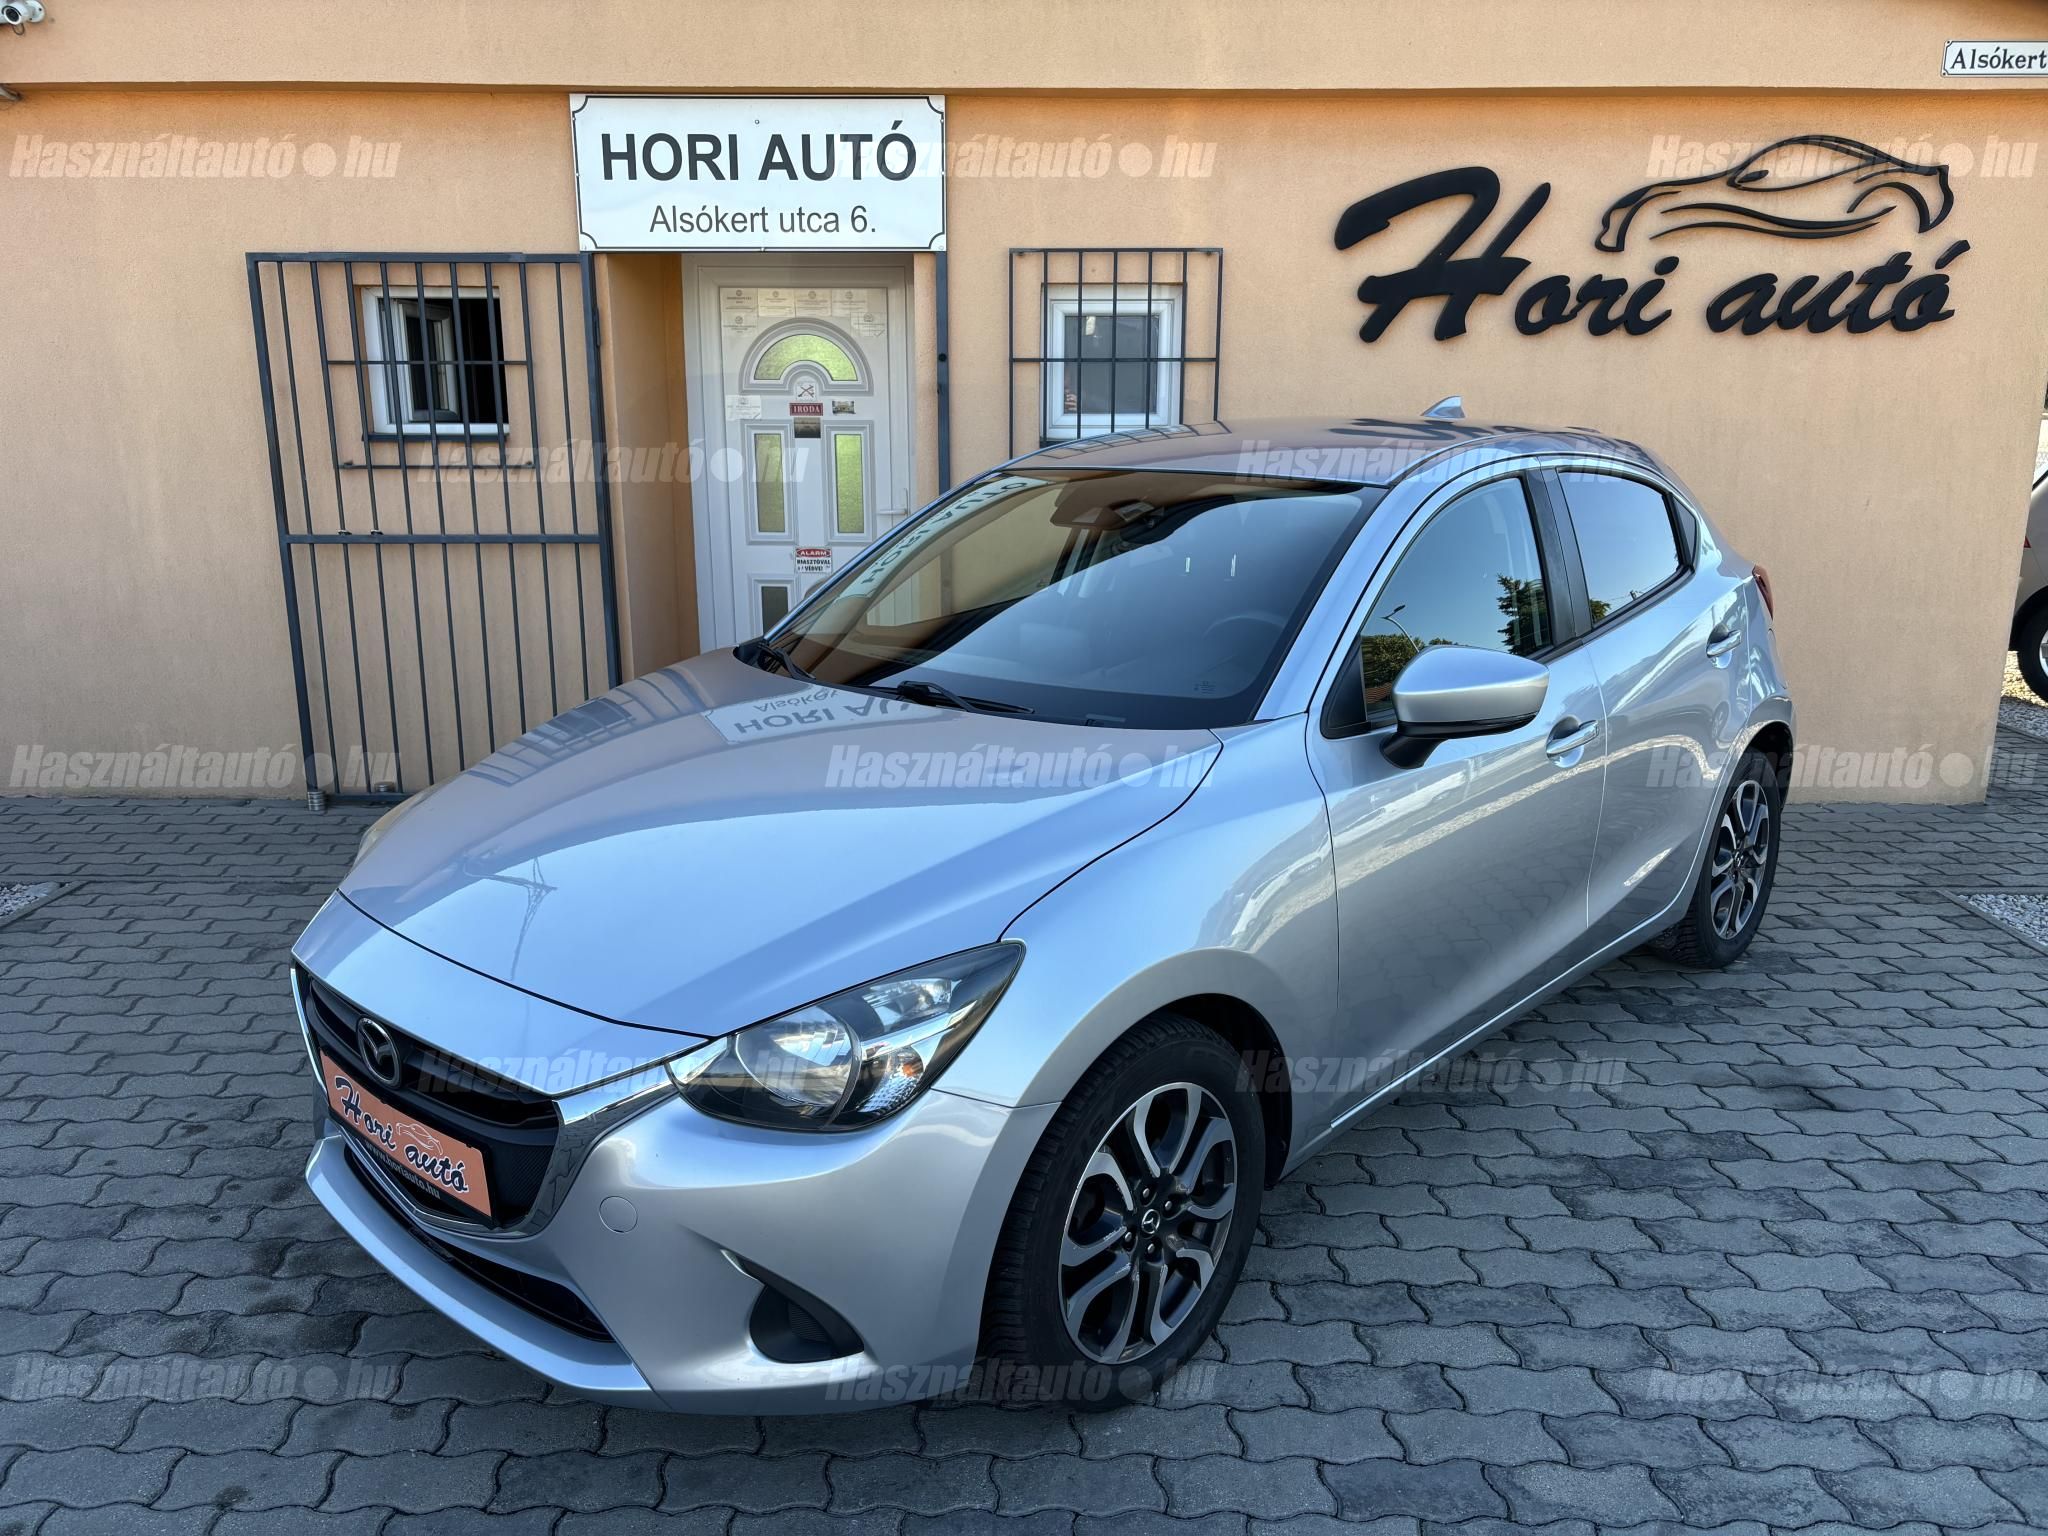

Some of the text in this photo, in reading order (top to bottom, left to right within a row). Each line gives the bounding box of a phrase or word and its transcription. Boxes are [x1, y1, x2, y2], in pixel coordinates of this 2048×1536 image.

[1950, 46, 2047, 69] Alsókert
[601, 120, 917, 181] HORI AUTÓ
[650, 205, 876, 233] Alsókert utca 6.
[1334, 166, 1970, 343] Hori autó
[793, 404, 821, 414] IRODA
[335, 1075, 469, 1194] Hori autó
